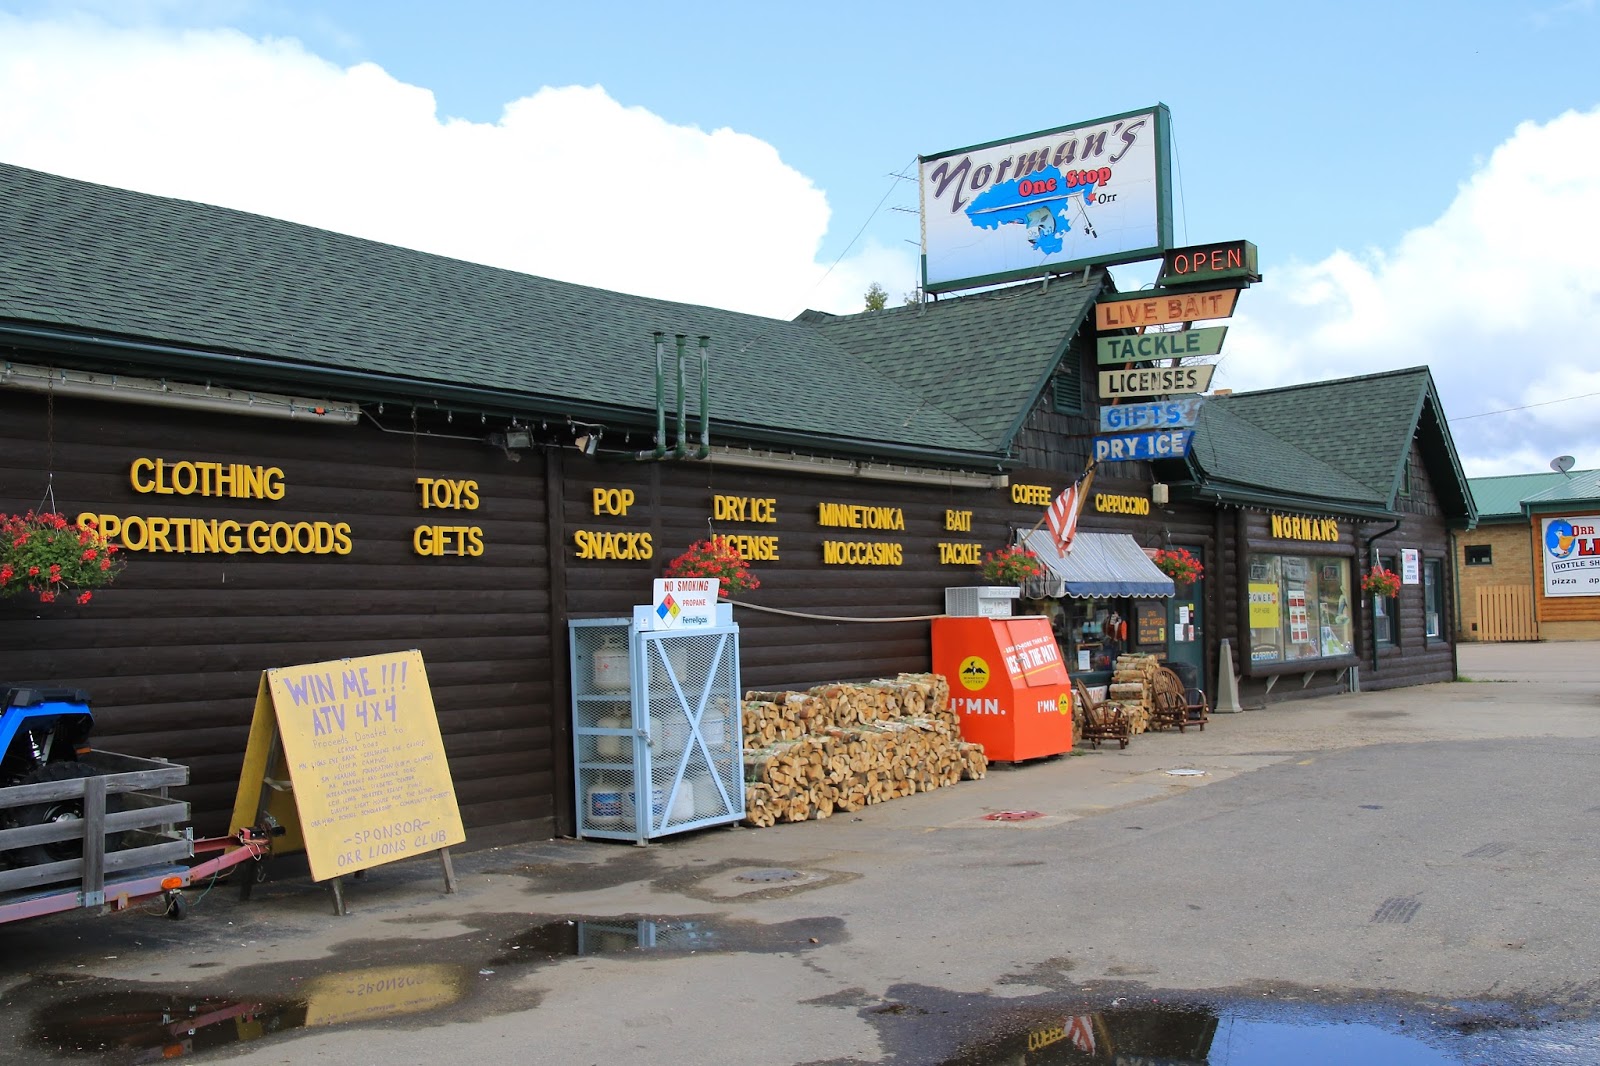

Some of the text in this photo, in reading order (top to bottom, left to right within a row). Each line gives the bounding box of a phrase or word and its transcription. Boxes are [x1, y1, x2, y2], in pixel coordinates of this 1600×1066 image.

[930, 118, 1147, 215] Norman's
[1018, 166, 1112, 198] One Stop
[1098, 192, 1117, 205] Orr
[1174, 248, 1241, 275] OPEN
[1105, 294, 1223, 325] LIVE BAIT
[1107, 333, 1201, 359] TACKLE
[1109, 369, 1198, 393] LICENSES
[1107, 404, 1181, 428] GIFTS
[1096, 433, 1184, 463] DRY ICE
[130, 457, 285, 501] CLOTHING
[416, 477, 480, 510] TOYS
[593, 487, 635, 517] POP
[1012, 484, 1150, 515] COFFEE CAPPUCCINO
[714, 494, 777, 523] DRY ICE
[818, 501, 905, 531] MINNETONKA
[945, 509, 973, 533] BAIT
[76, 512, 353, 556] SPORTING GOODS
[413, 524, 485, 557] GIFTS
[1271, 515, 1339, 542] NORMAN'S
[1572, 525, 1595, 537] ORR
[574, 530, 653, 561] SNACKS
[823, 540, 903, 566] MOCCASINS
[938, 542, 982, 566] TACKLE
[1555, 561, 1586, 570] BOTTLE
[664, 580, 709, 592] NO SMOKING
[1552, 577, 1577, 585] pizza
[682, 599, 706, 607] PROPANE
[682, 616, 708, 626] Ferrellgas
[1006, 655, 1021, 674] ICE
[1028, 648, 1043, 667] THE
[283, 673, 336, 707] WIN
[342, 667, 377, 700] ME
[312, 703, 345, 736] ATV
[312, 734, 349, 749] Proceeds
[354, 727, 387, 742] Donated
[338, 745, 359, 753] LEADER
[337, 830, 446, 868] ORR LIONS CLUB
